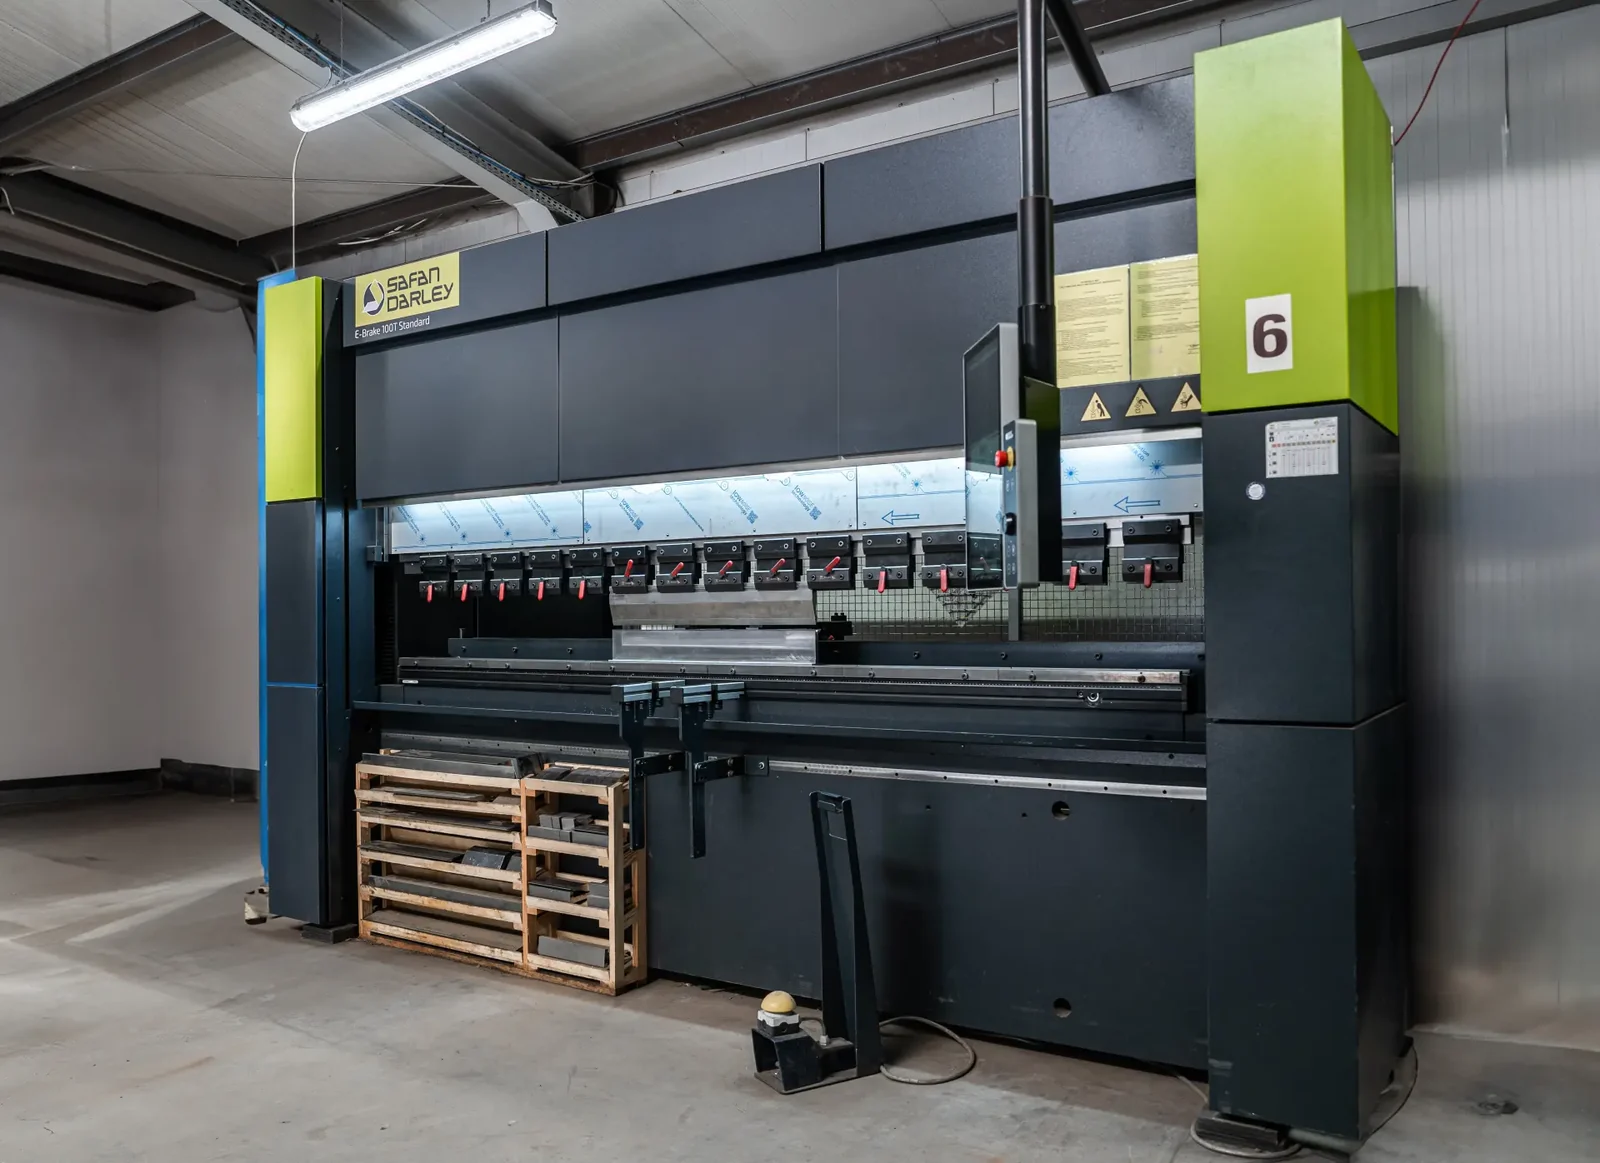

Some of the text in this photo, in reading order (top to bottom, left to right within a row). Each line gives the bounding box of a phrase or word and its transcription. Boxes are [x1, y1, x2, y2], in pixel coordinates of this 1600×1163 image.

[354, 316, 430, 339] E-Brake 100T Standard
[1252, 313, 1288, 358] 6
